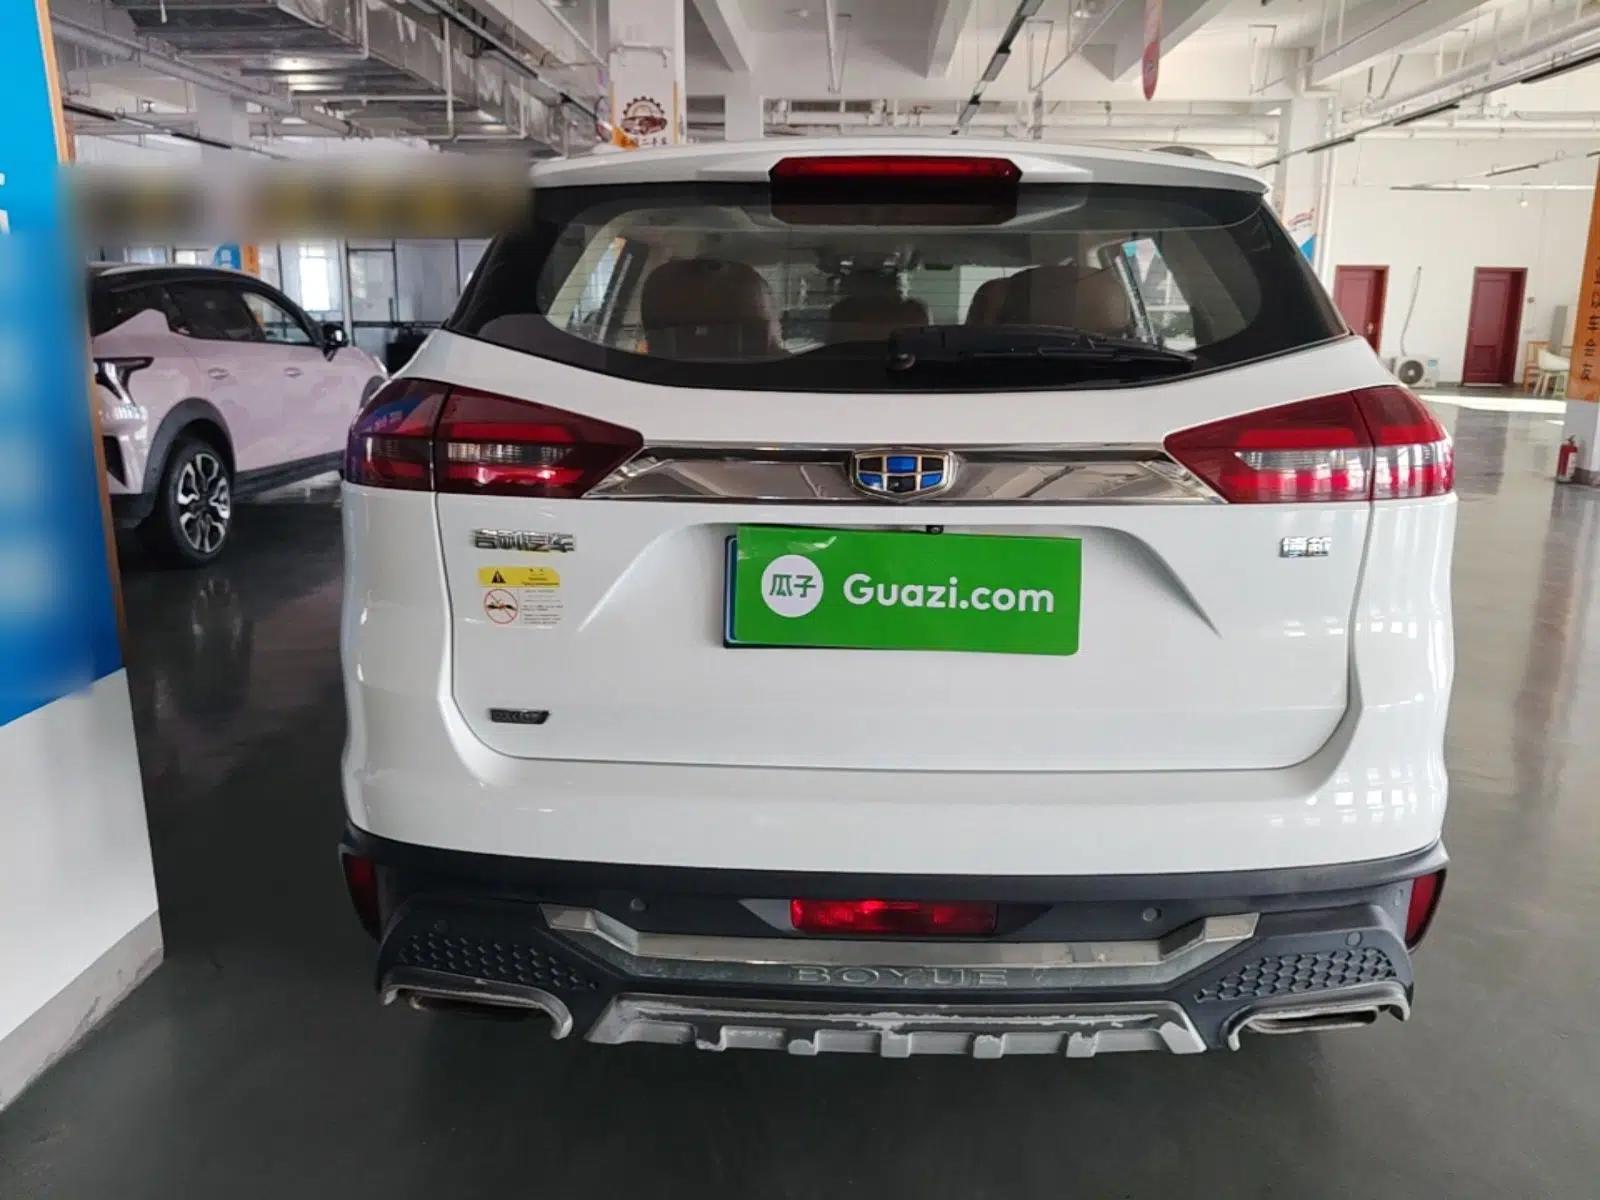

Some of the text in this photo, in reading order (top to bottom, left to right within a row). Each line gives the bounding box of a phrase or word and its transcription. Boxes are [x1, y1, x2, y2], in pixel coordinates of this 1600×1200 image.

[473, 529, 575, 552] 吉利汽车
[769, 574, 817, 599] 瓜子
[843, 572, 1055, 613] Guazi.com
[796, 965, 1009, 988] BOYUE
